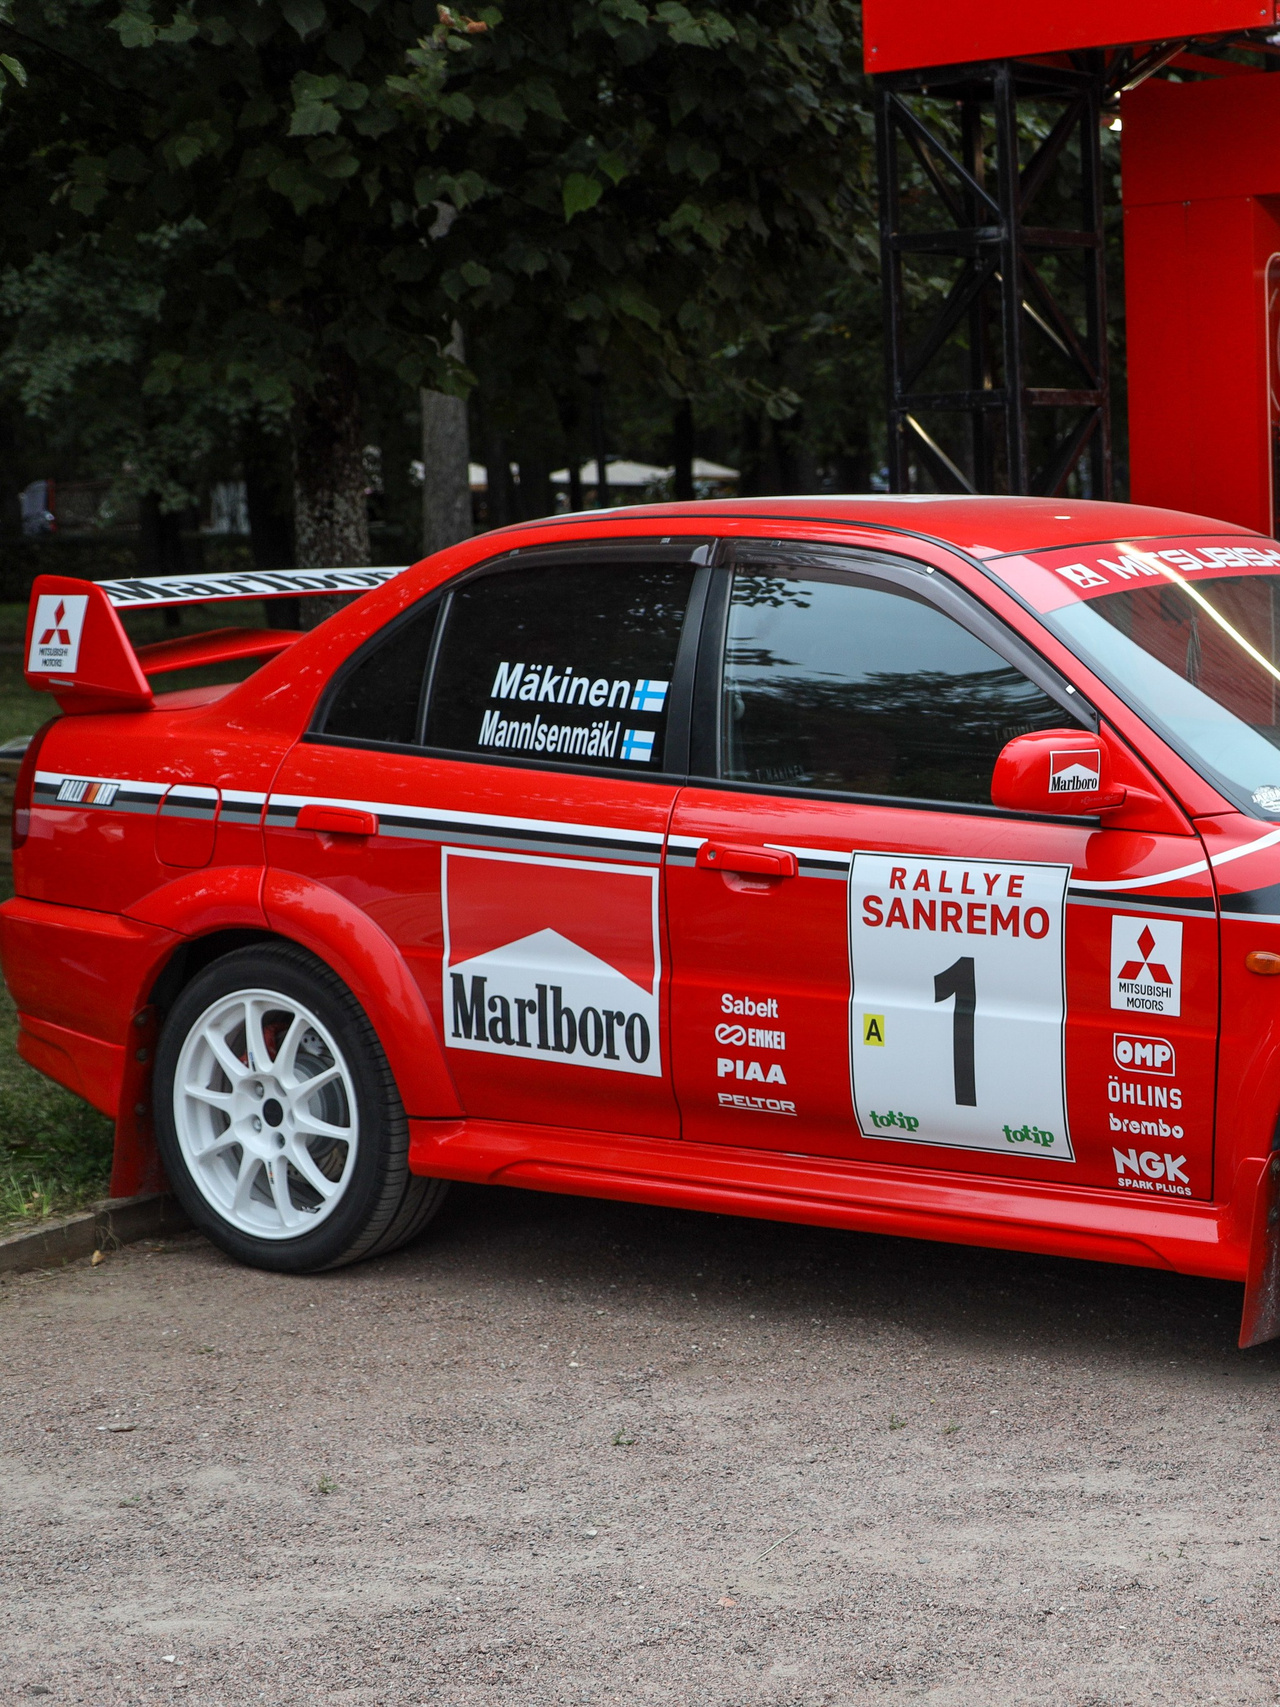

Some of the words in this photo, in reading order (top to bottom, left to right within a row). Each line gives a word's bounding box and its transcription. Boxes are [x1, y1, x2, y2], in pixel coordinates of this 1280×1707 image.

[104, 570, 404, 602] Marlbor
[490, 661, 631, 709] Mäkinen
[1050, 775, 1098, 792] Marlboro
[889, 866, 1025, 899] RALLYE
[862, 894, 1050, 940] SANREMO
[1118, 981, 1172, 999] MITSUBISHI
[449, 971, 651, 1064] Marlboro
[720, 993, 779, 1019] Sabelt
[1126, 996, 1164, 1012] MOTORS
[748, 1027, 786, 1050] ENKEI
[865, 1017, 883, 1044] A
[933, 956, 978, 1108] 1
[1116, 1040, 1171, 1068] OMP
[717, 1057, 787, 1085] PIAA
[717, 1092, 798, 1114] PELTOR
[1107, 1075, 1183, 1110] ÖHLINS
[869, 1110, 920, 1133] totip
[1108, 1112, 1185, 1139] brembo
[1002, 1124, 1055, 1148] totip
[1112, 1146, 1190, 1185] NGK
[1117, 1177, 1155, 1191] SPARK
[1155, 1182, 1193, 1196] PLUGS
